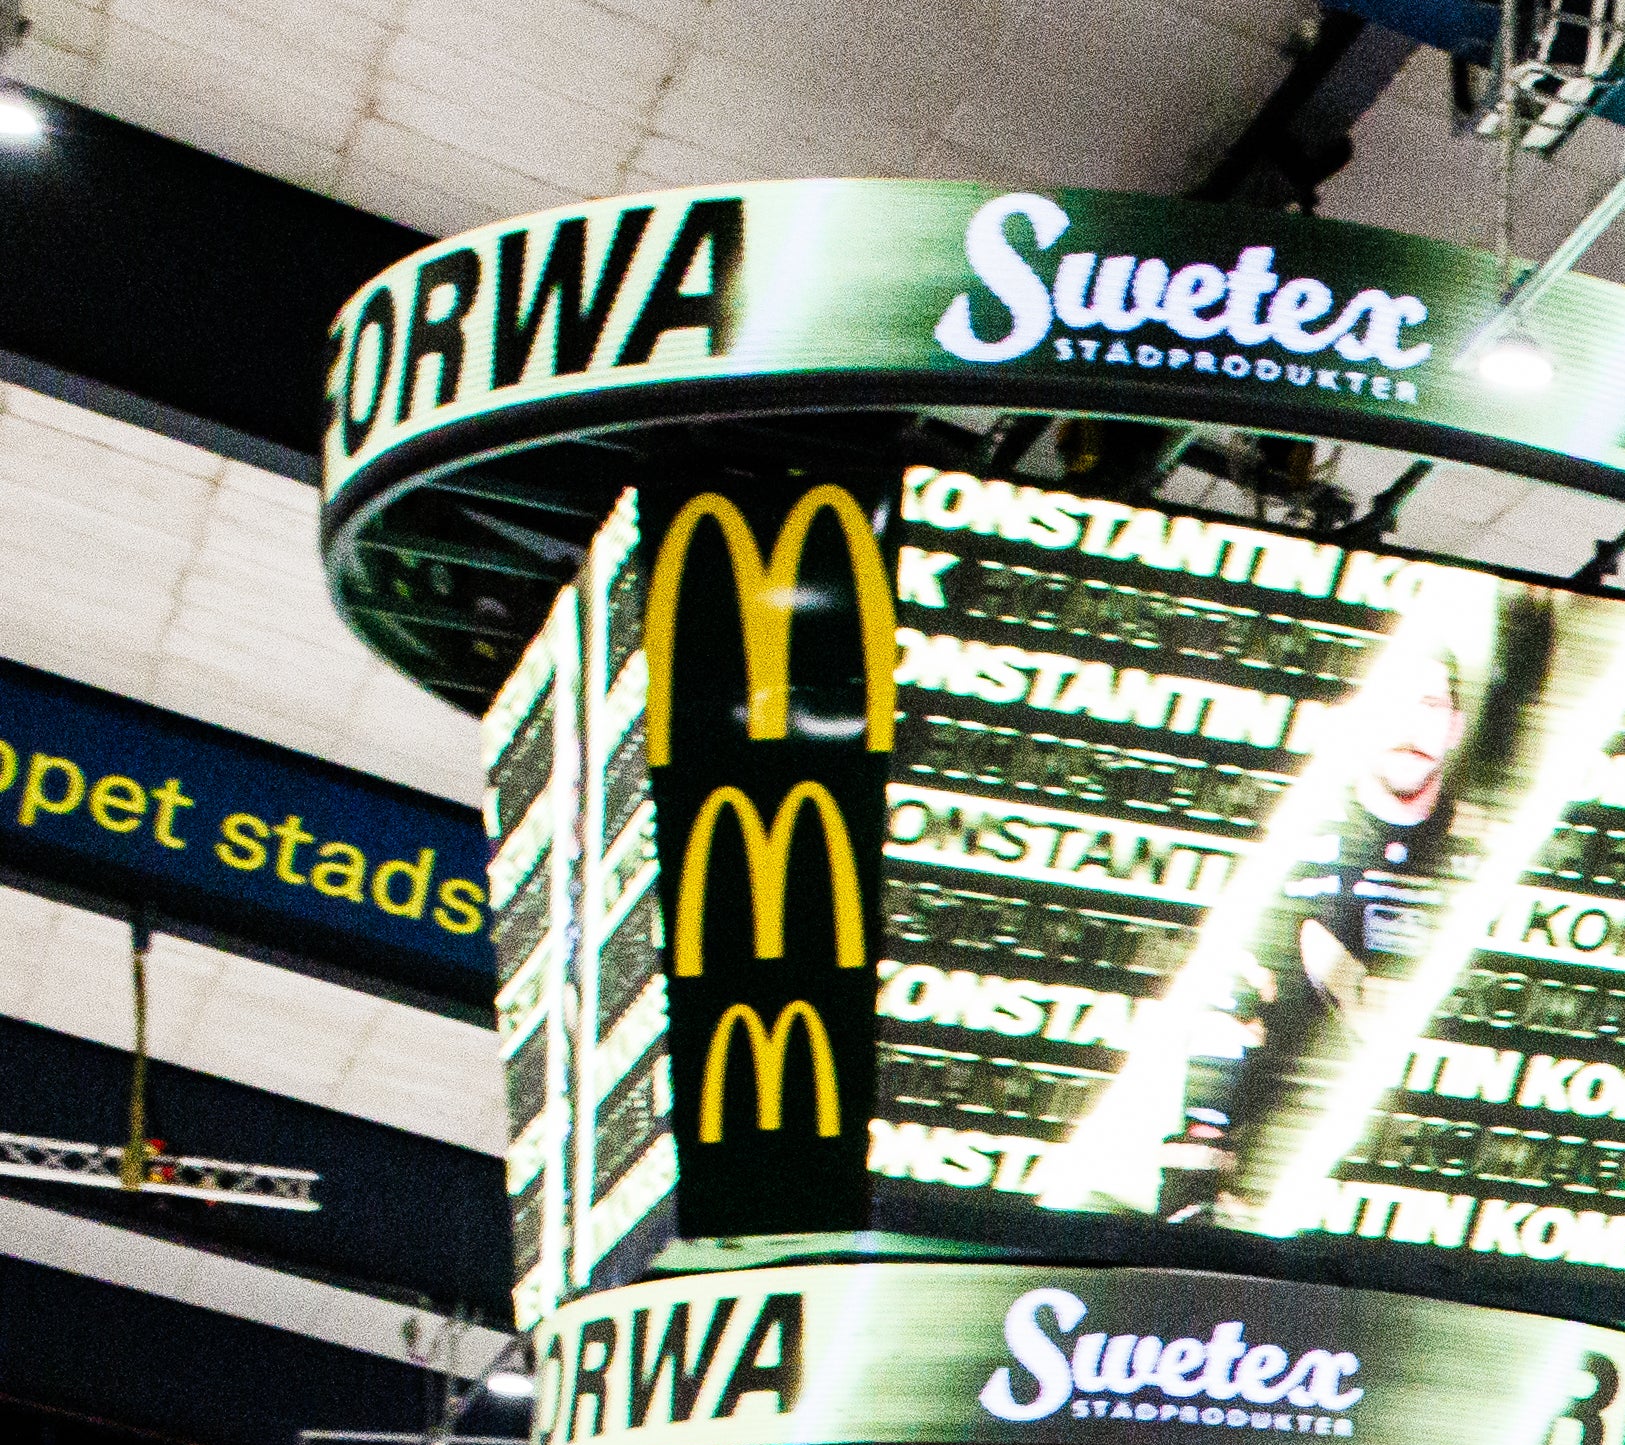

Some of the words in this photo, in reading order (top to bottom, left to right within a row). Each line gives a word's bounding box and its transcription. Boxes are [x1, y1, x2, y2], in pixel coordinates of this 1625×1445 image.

[935, 192, 1433, 371] Swetex
[1054, 337, 1419, 405] STADPRODUKTER
[214, 812, 489, 935] stads
[980, 1288, 1363, 1421] Swetex
